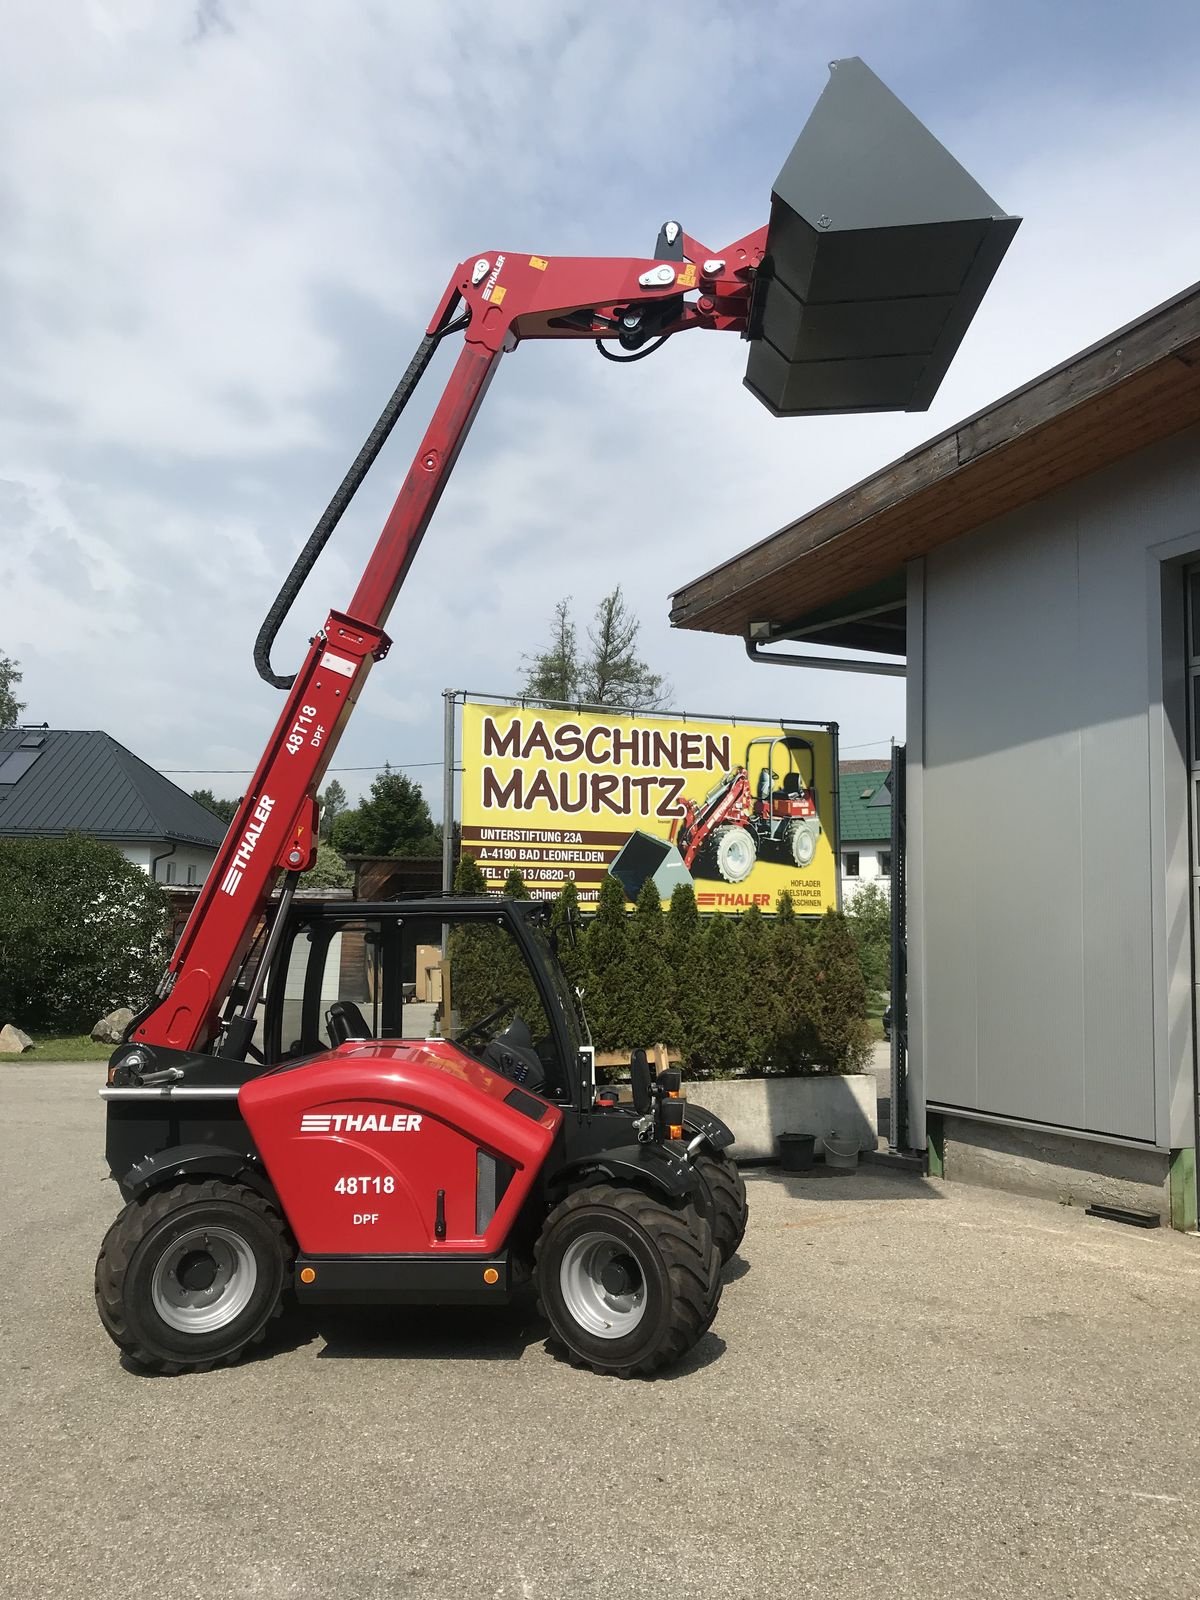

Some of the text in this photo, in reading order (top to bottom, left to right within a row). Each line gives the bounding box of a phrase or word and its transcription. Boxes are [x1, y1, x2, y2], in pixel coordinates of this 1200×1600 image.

[285, 705, 317, 755] 48T18
[311, 725, 325, 747] DPF
[483, 718, 730, 771] MASCHINEN
[483, 767, 685, 816] MAURITZ
[231, 795, 275, 869] THALER
[480, 829, 582, 843] UNTERSTIFTUNG 23A
[480, 848, 604, 862] A-4190 BAD LEONFELDEN
[480, 868, 575, 880] TEL: 013/6820-0
[715, 894, 770, 906] THALER
[331, 1114, 422, 1132] THALER
[334, 1176, 395, 1195] 48T18
[353, 1213, 379, 1225] DPF
